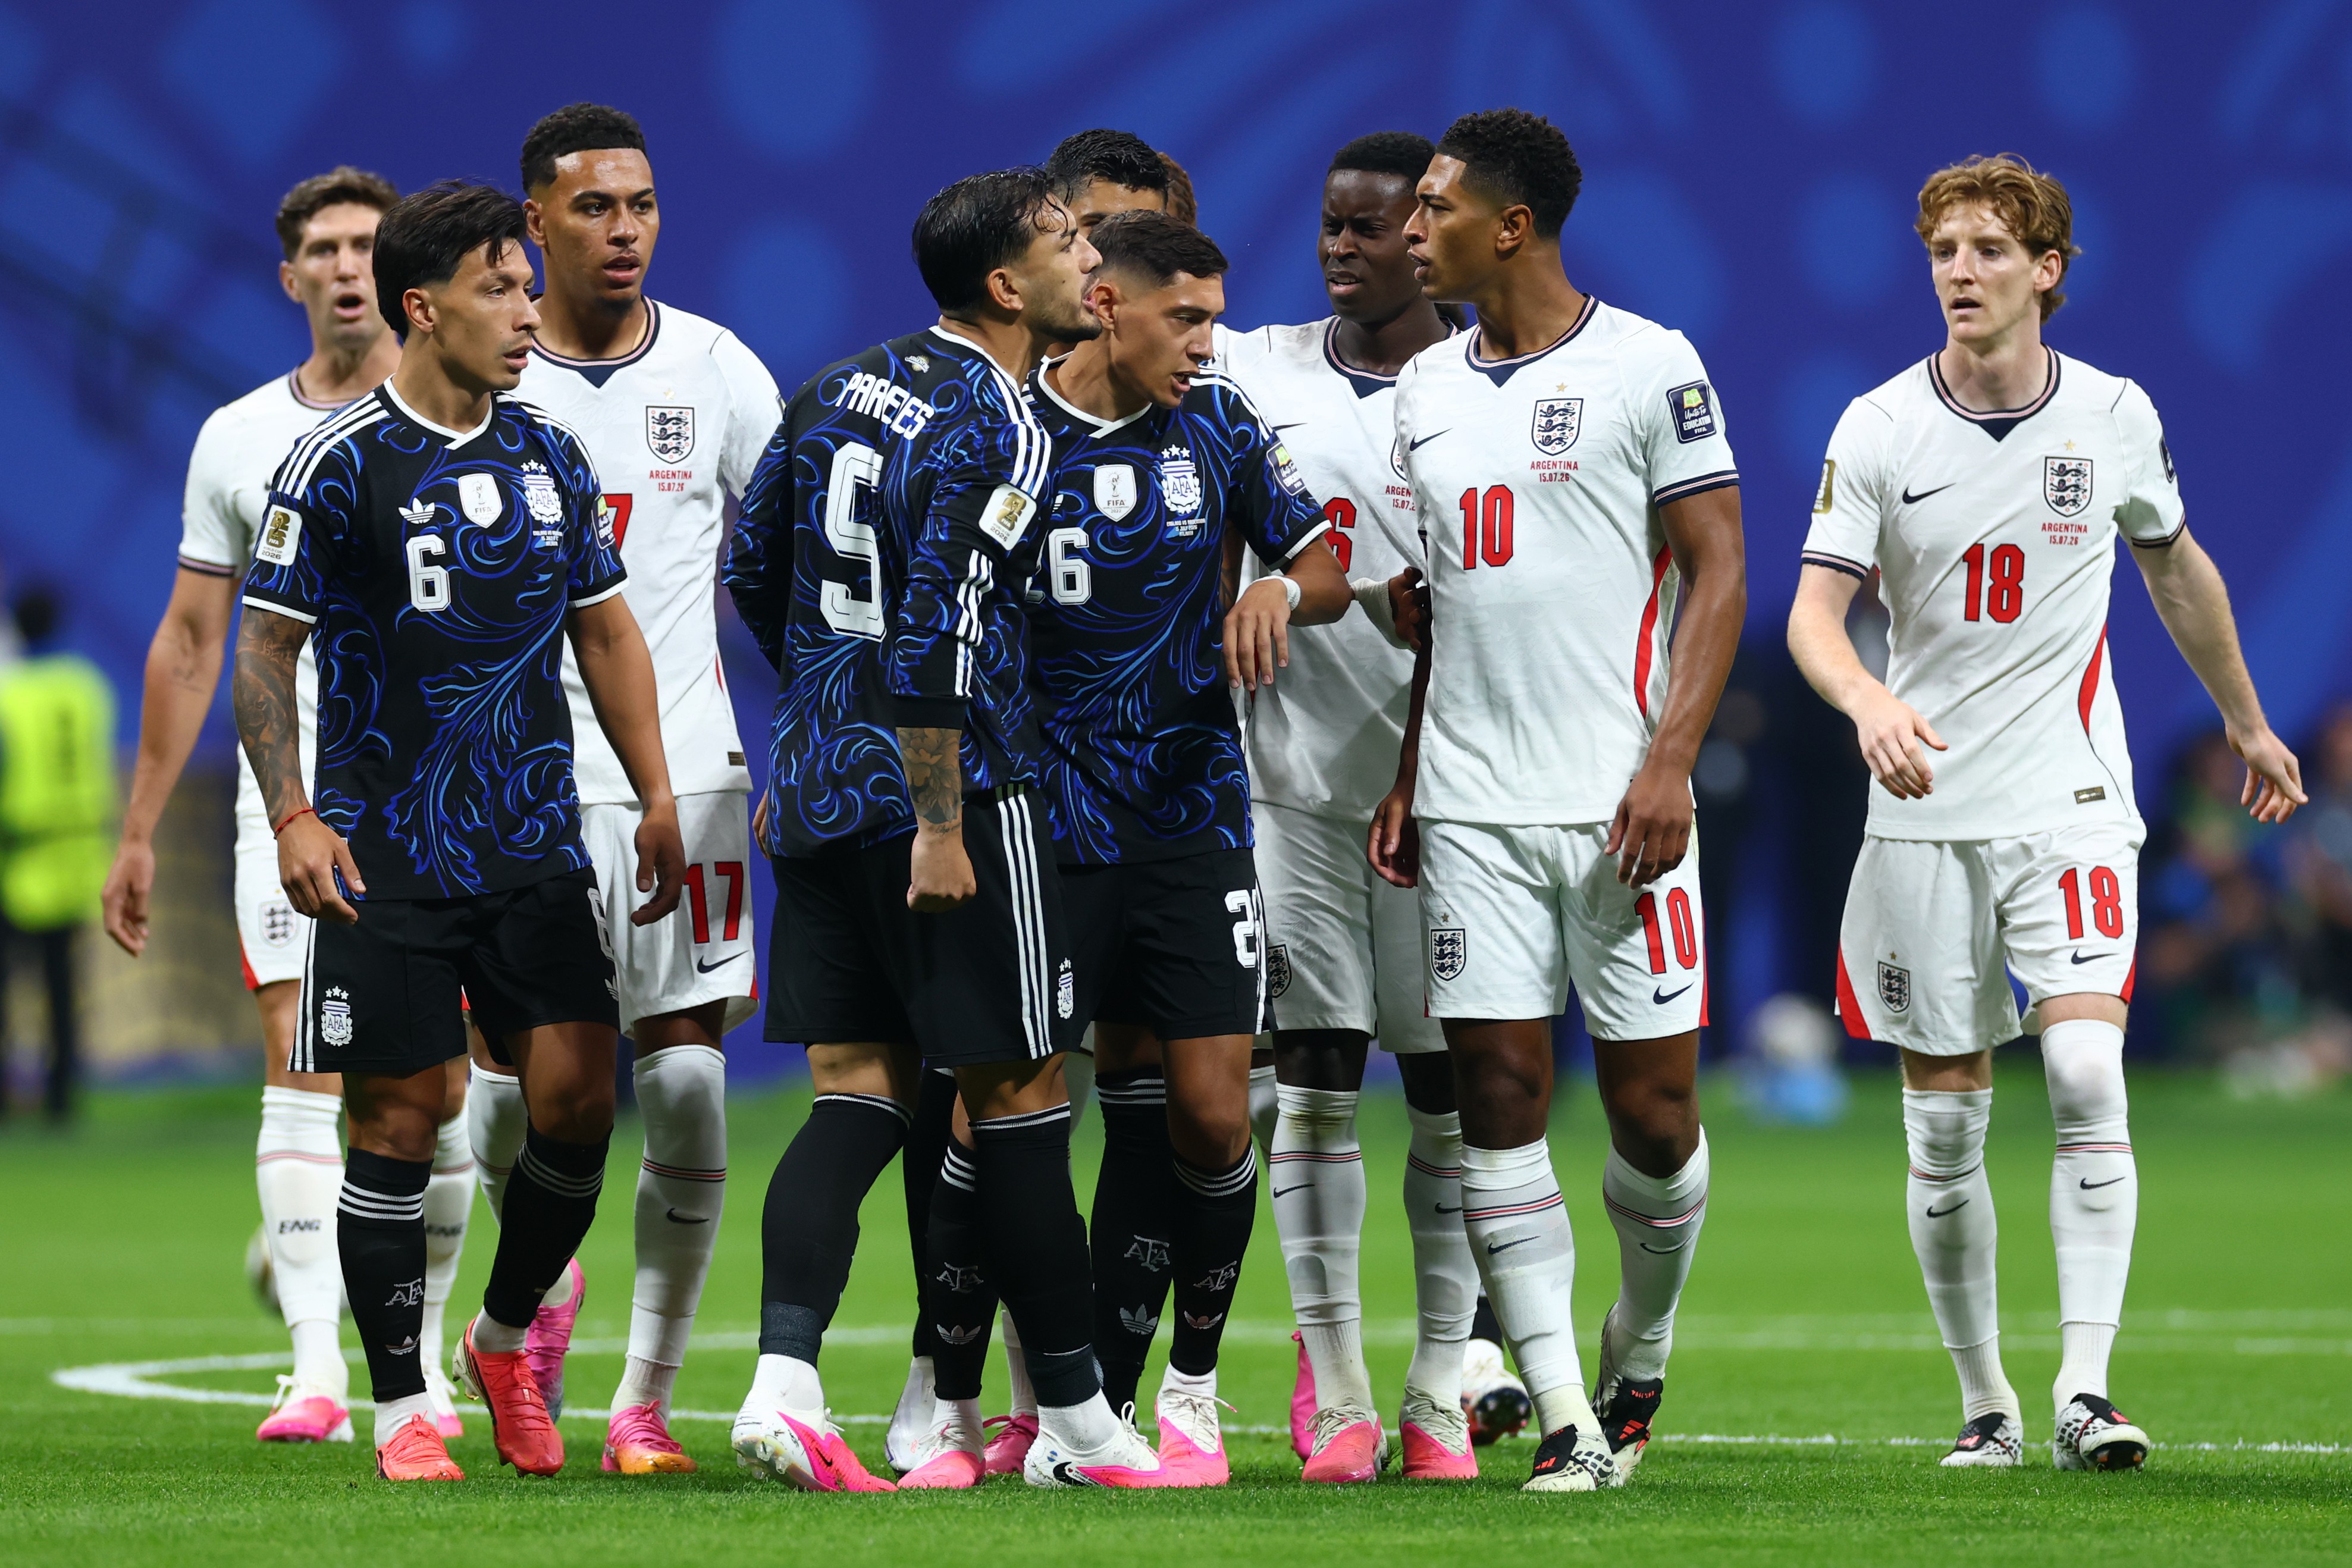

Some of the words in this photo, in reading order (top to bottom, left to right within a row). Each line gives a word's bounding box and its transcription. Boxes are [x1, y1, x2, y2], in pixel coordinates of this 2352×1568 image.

[835, 372, 934, 440] PAREES
[649, 470, 692, 479] ARGENTINA
[1530, 460, 1579, 471] ARGENTINA
[658, 482, 685, 492] 15.07.26
[1172, 475, 1193, 498] AFA
[1539, 472, 1570, 482] 15.07.26
[535, 488, 554, 509] AFA
[1385, 485, 1412, 498] ARGEN
[1393, 498, 1416, 512] 15.07.2
[990, 526, 1008, 542] 2026
[1001, 518, 1012, 528] FIFA
[1459, 484, 1514, 570] 10
[2041, 522, 2088, 534] ARGENTINA
[820, 441, 887, 642] 5
[2049, 535, 2079, 545] 15.07.26
[261, 550, 282, 560] 2026
[405, 534, 451, 612] 6
[1024, 527, 1092, 606] 6
[1963, 542, 2025, 623] 18
[682, 861, 744, 945] 17
[2058, 865, 2124, 940] 18
[1635, 886, 1698, 975] 10
[327, 1012, 345, 1033] AFA
[279, 1219, 322, 1234] ENG
[1123, 1234, 1171, 1272] AFA
[936, 1262, 984, 1294] AFA
[1193, 1260, 1237, 1292] AFA
[384, 1277, 424, 1307] AFA
